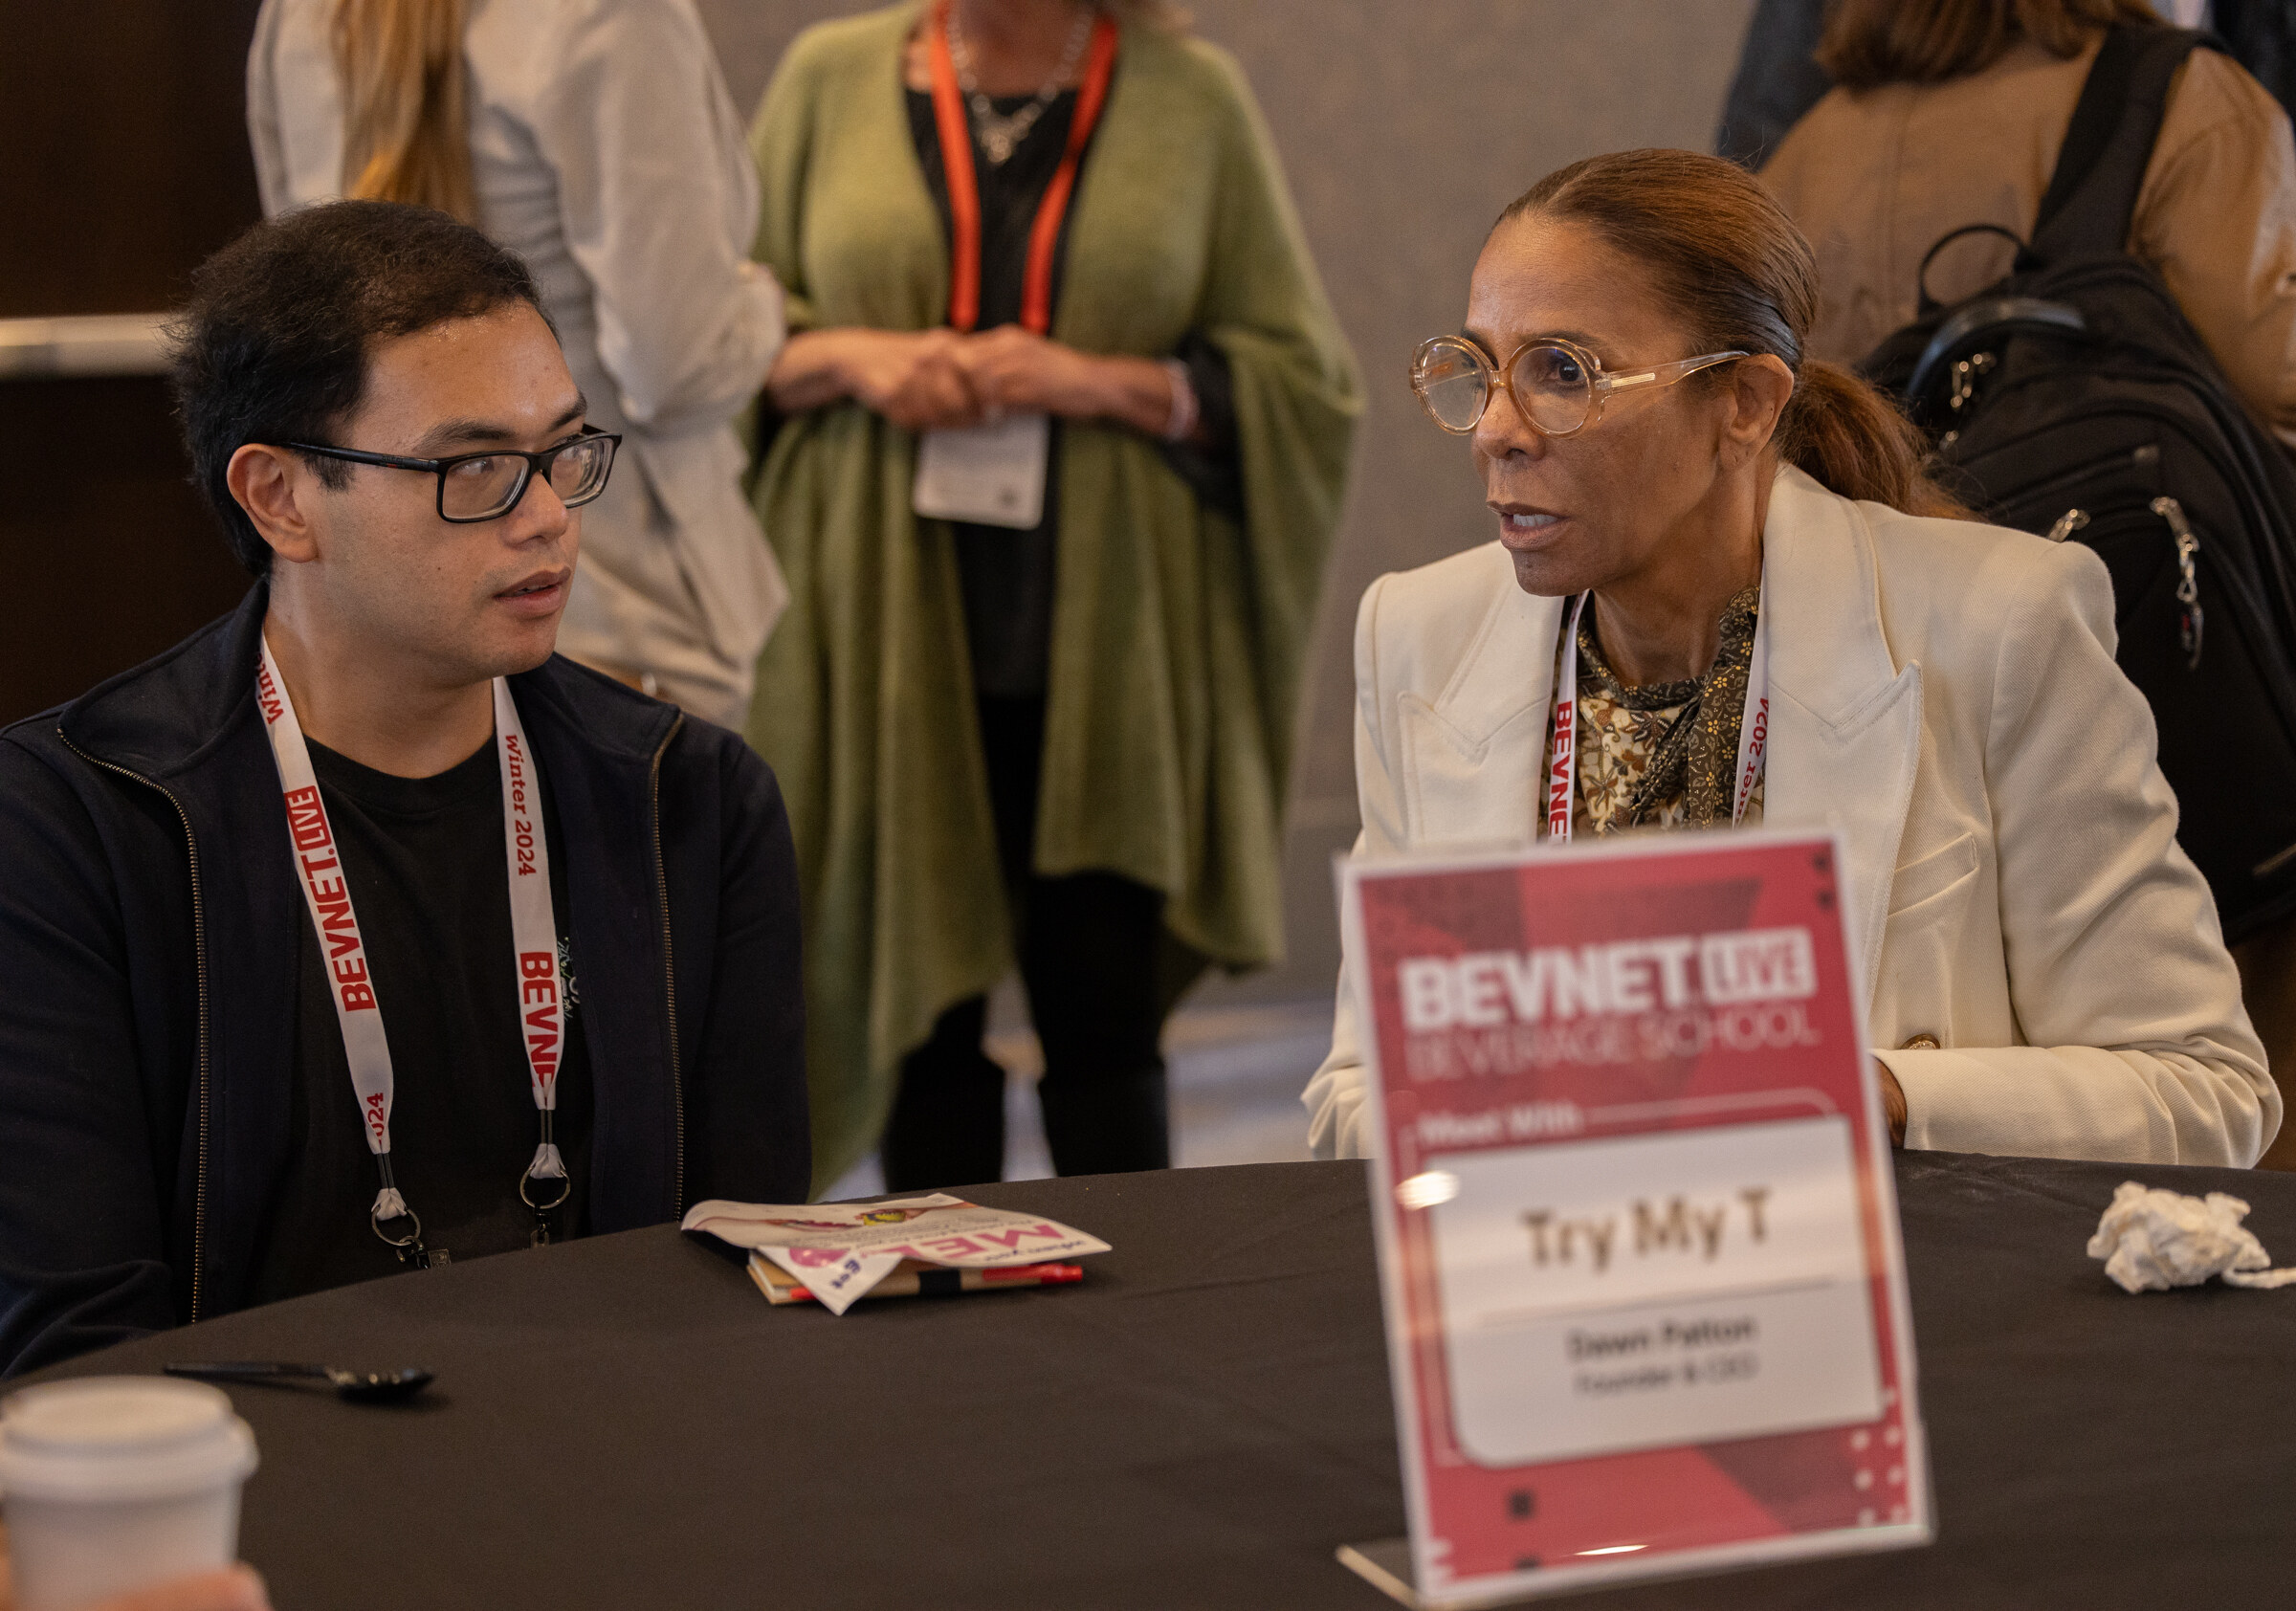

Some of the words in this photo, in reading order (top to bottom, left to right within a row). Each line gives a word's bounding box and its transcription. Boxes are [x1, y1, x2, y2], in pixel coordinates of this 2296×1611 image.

[505, 735, 527, 814] Winter
[1548, 700, 1572, 843] BEVNE
[1734, 761, 1756, 825] nter
[515, 820, 537, 875] 2024
[1401, 940, 1692, 1031] BEVNET
[1708, 938, 1805, 997] LIVE
[1637, 1004, 1821, 1059] SCHOOL
[366, 1092, 385, 1145] 024
[1519, 1208, 1617, 1274] Try
[1631, 1195, 1725, 1265] My
[1739, 1186, 1772, 1242] T
